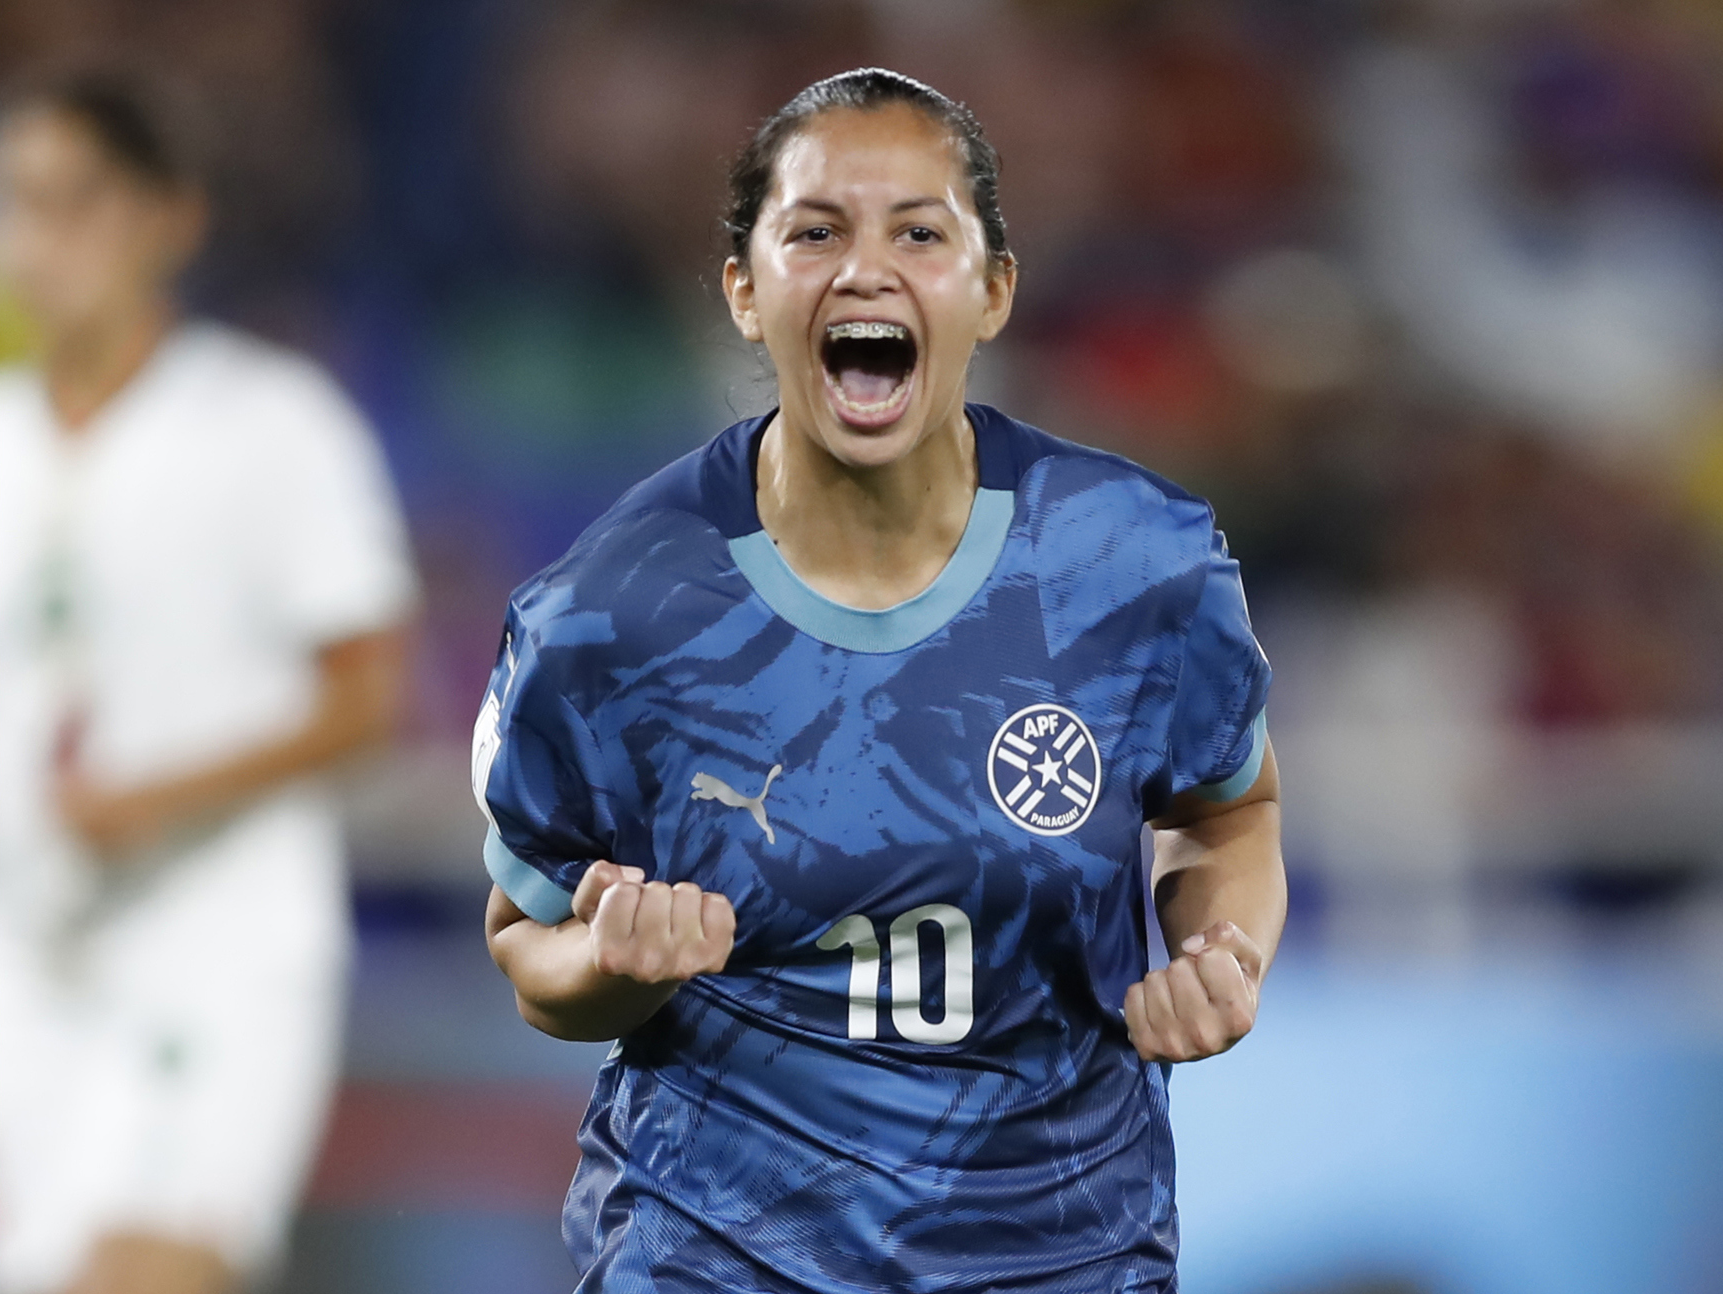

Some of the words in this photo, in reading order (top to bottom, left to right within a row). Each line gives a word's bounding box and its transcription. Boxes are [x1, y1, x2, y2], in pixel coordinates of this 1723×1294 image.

[1023, 713, 1059, 740] APF
[1030, 805, 1081, 828] PARAGUAY
[815, 903, 975, 1046] 10
